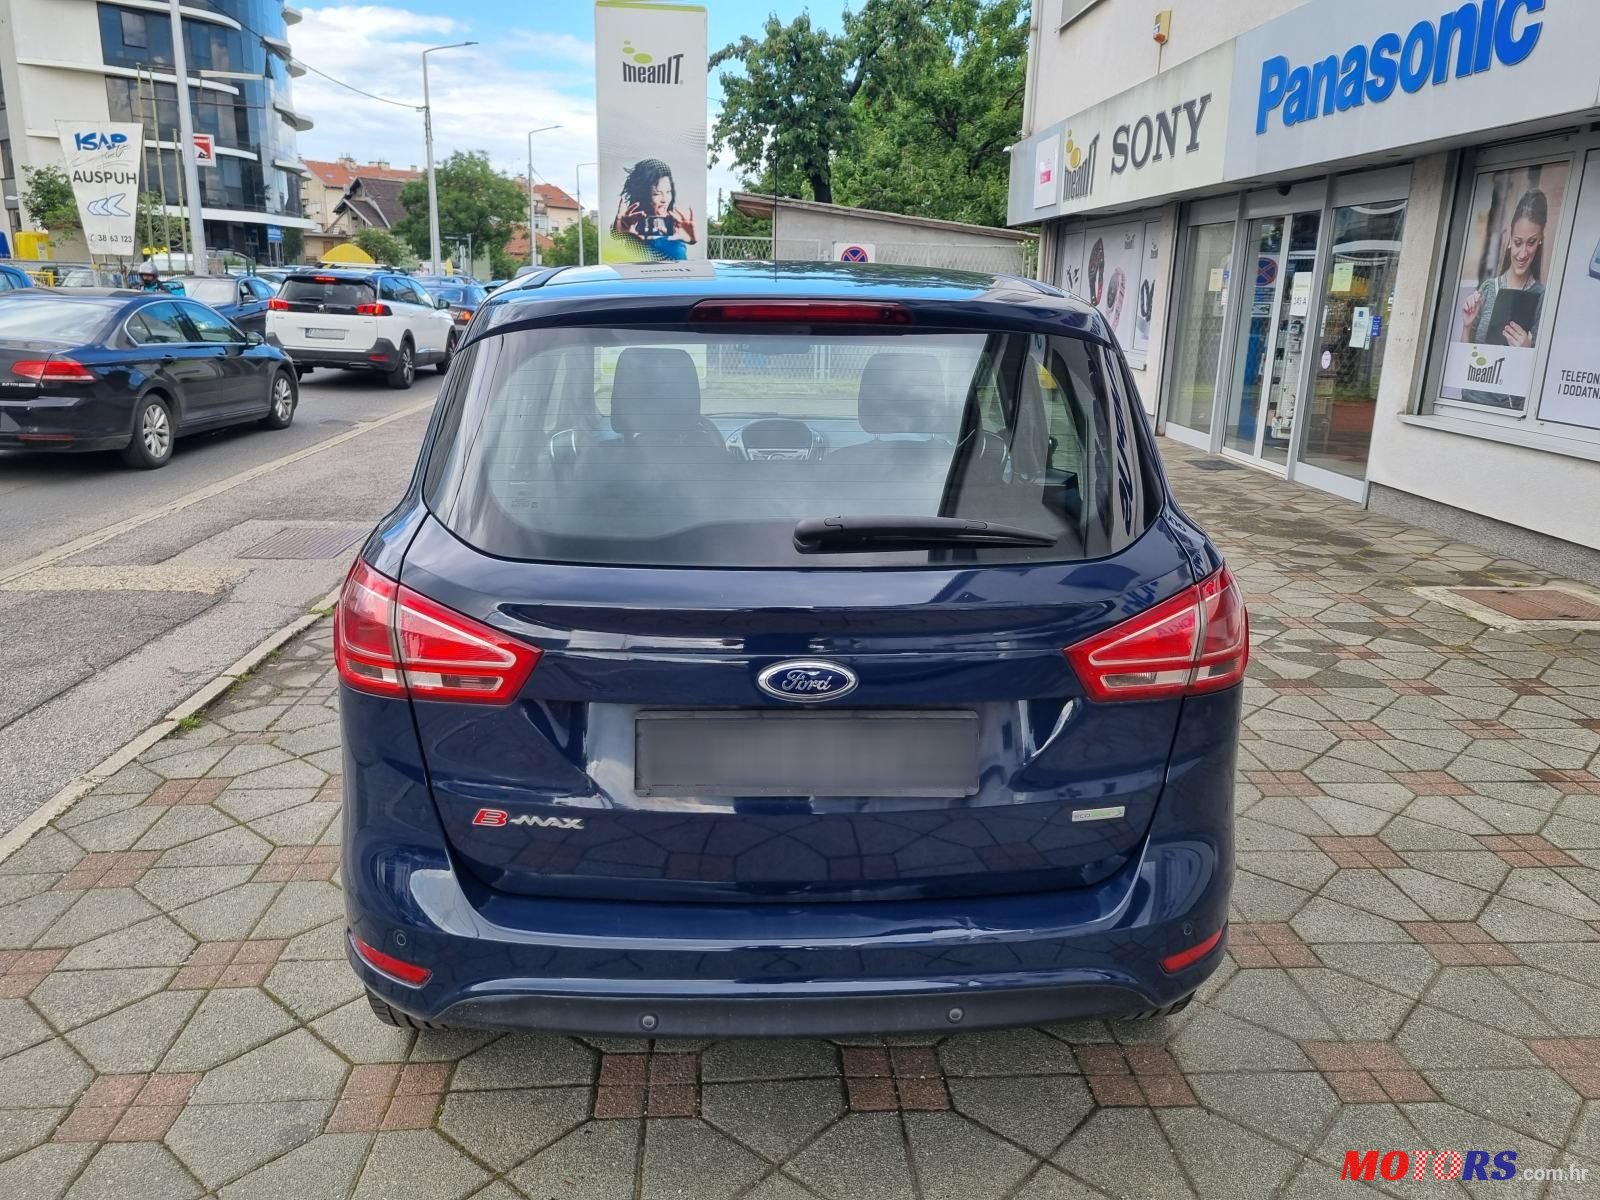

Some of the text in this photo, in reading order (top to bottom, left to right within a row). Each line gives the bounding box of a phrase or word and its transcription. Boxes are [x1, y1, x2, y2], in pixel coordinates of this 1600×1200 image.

[622, 53, 684, 85] meanIT
[1256, 0, 1545, 136] Panasonic
[74, 132, 127, 151] ISAP
[1111, 92, 1212, 177] SONY
[72, 170, 137, 185] AUSPUH
[1063, 132, 1100, 201] meanIT
[97, 234, 107, 242] 38
[120, 235, 132, 243] 123
[1467, 357, 1505, 385] meanIT
[1561, 369, 1600, 385] TELEFON
[1557, 383, 1600, 400] I DODATN
[781, 669, 833, 691] Ford
[472, 808, 584, 830] B-MAX
